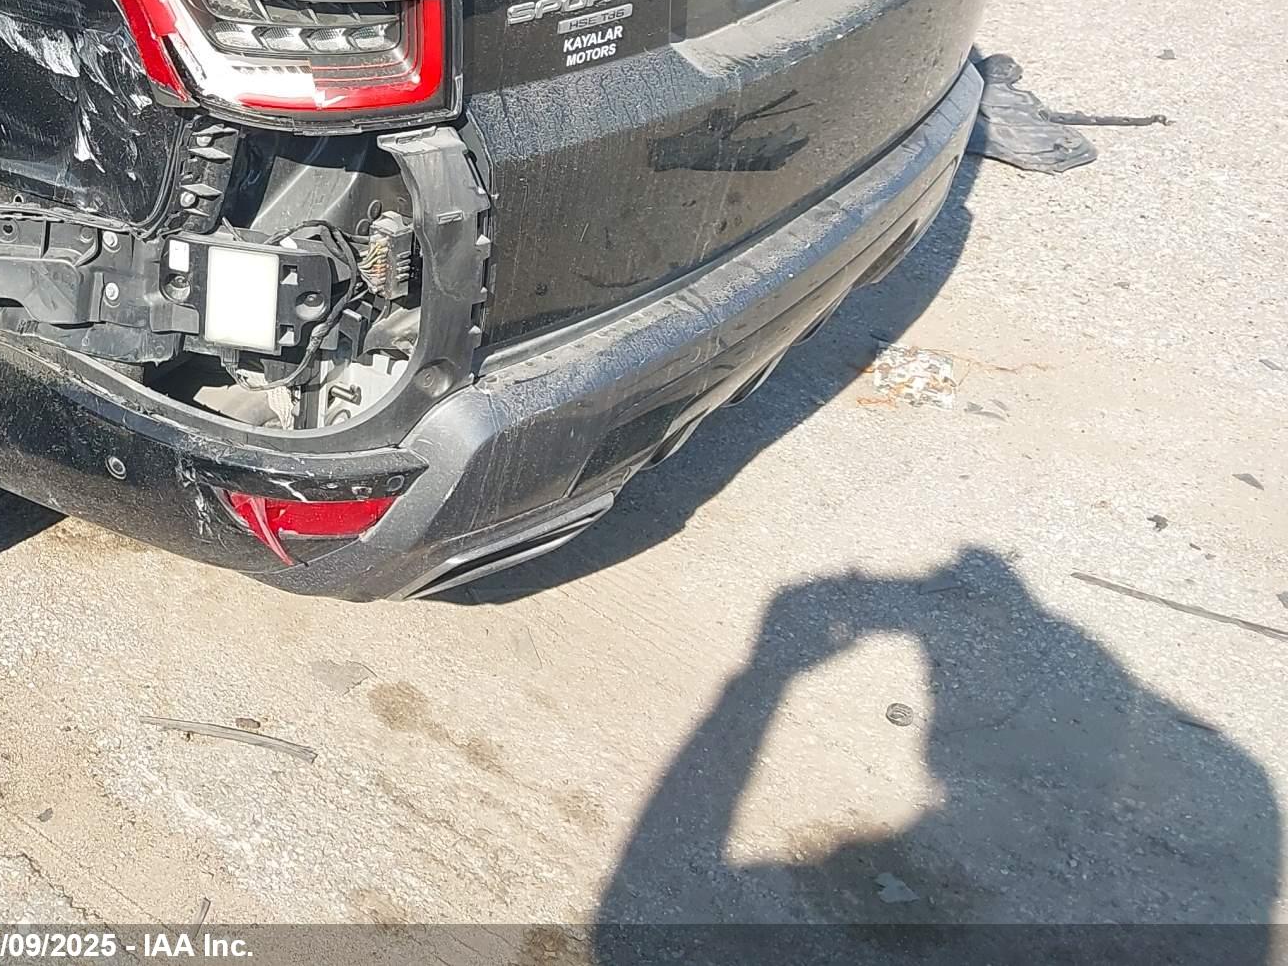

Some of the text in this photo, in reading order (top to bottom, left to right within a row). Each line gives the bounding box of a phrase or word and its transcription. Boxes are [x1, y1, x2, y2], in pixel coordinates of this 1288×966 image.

[569, 15, 598, 30] HSE
[563, 25, 623, 53] KAYALAR
[566, 43, 617, 67] MOTORS
